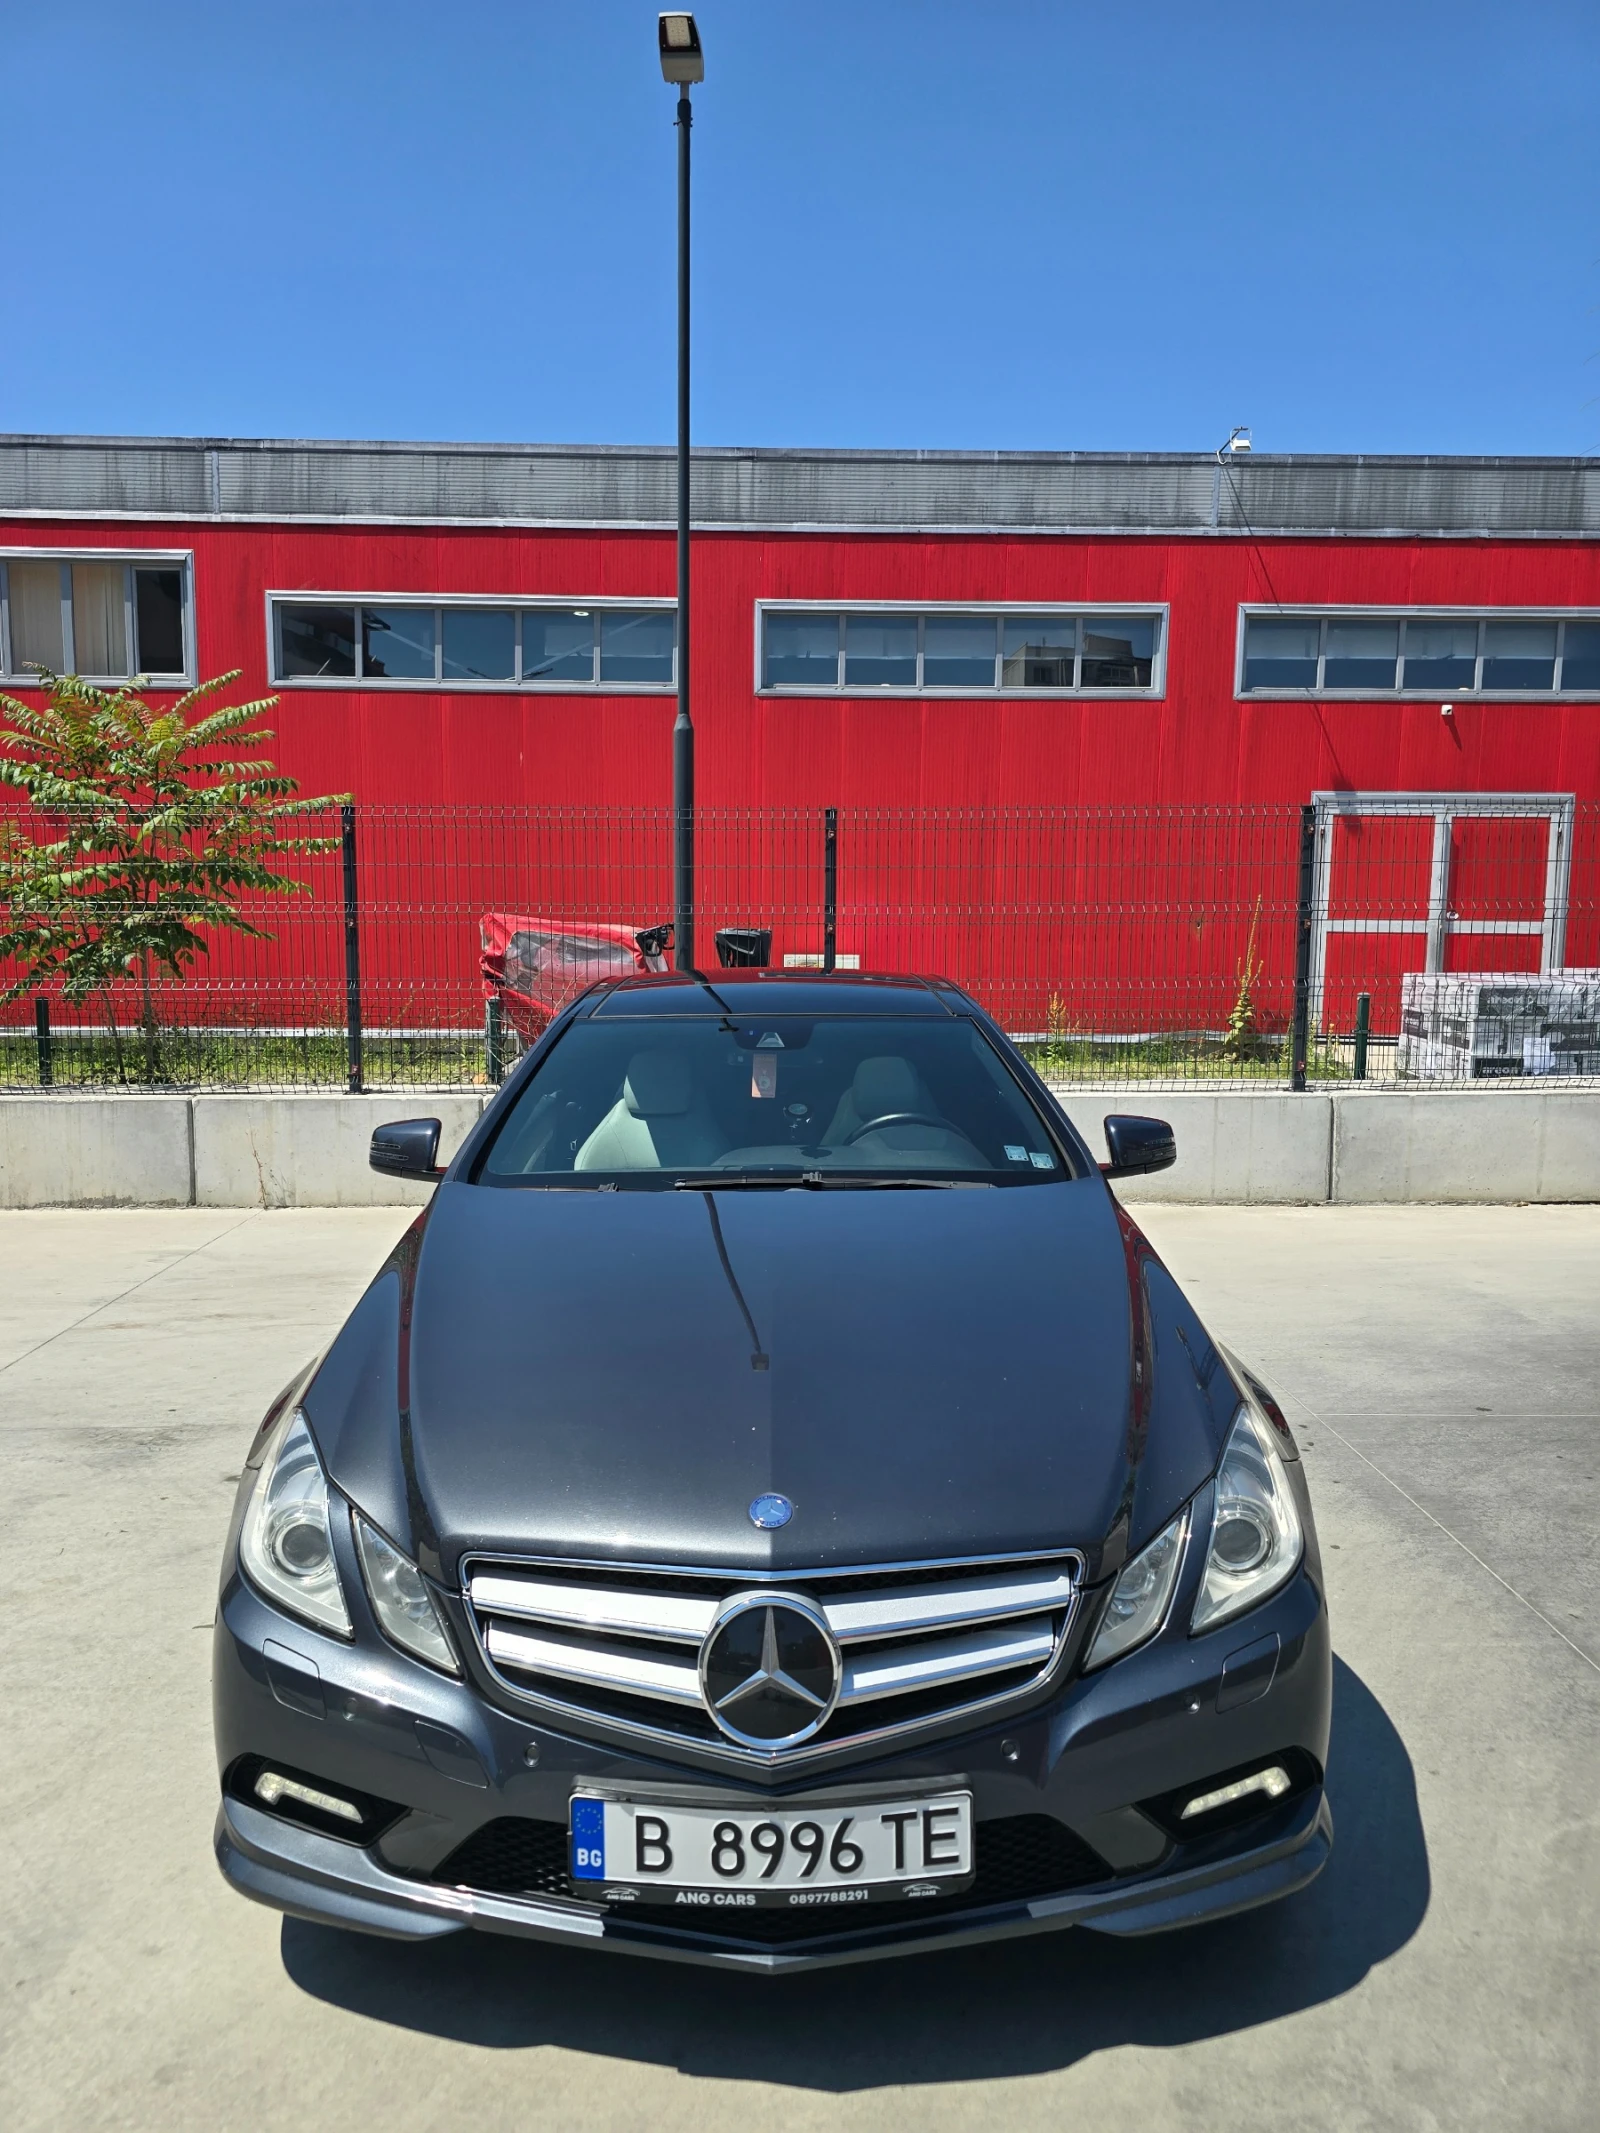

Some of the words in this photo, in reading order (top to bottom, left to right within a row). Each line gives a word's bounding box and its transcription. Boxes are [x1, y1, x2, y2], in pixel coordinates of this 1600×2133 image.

[635, 1815, 673, 1873] B
[711, 1817, 864, 1879] 8996
[880, 1807, 960, 1870] TE
[577, 1848, 602, 1868] BG
[675, 1892, 710, 1904] ANG
[713, 1893, 756, 1906] CARS
[789, 1889, 869, 1905] 0897788291
